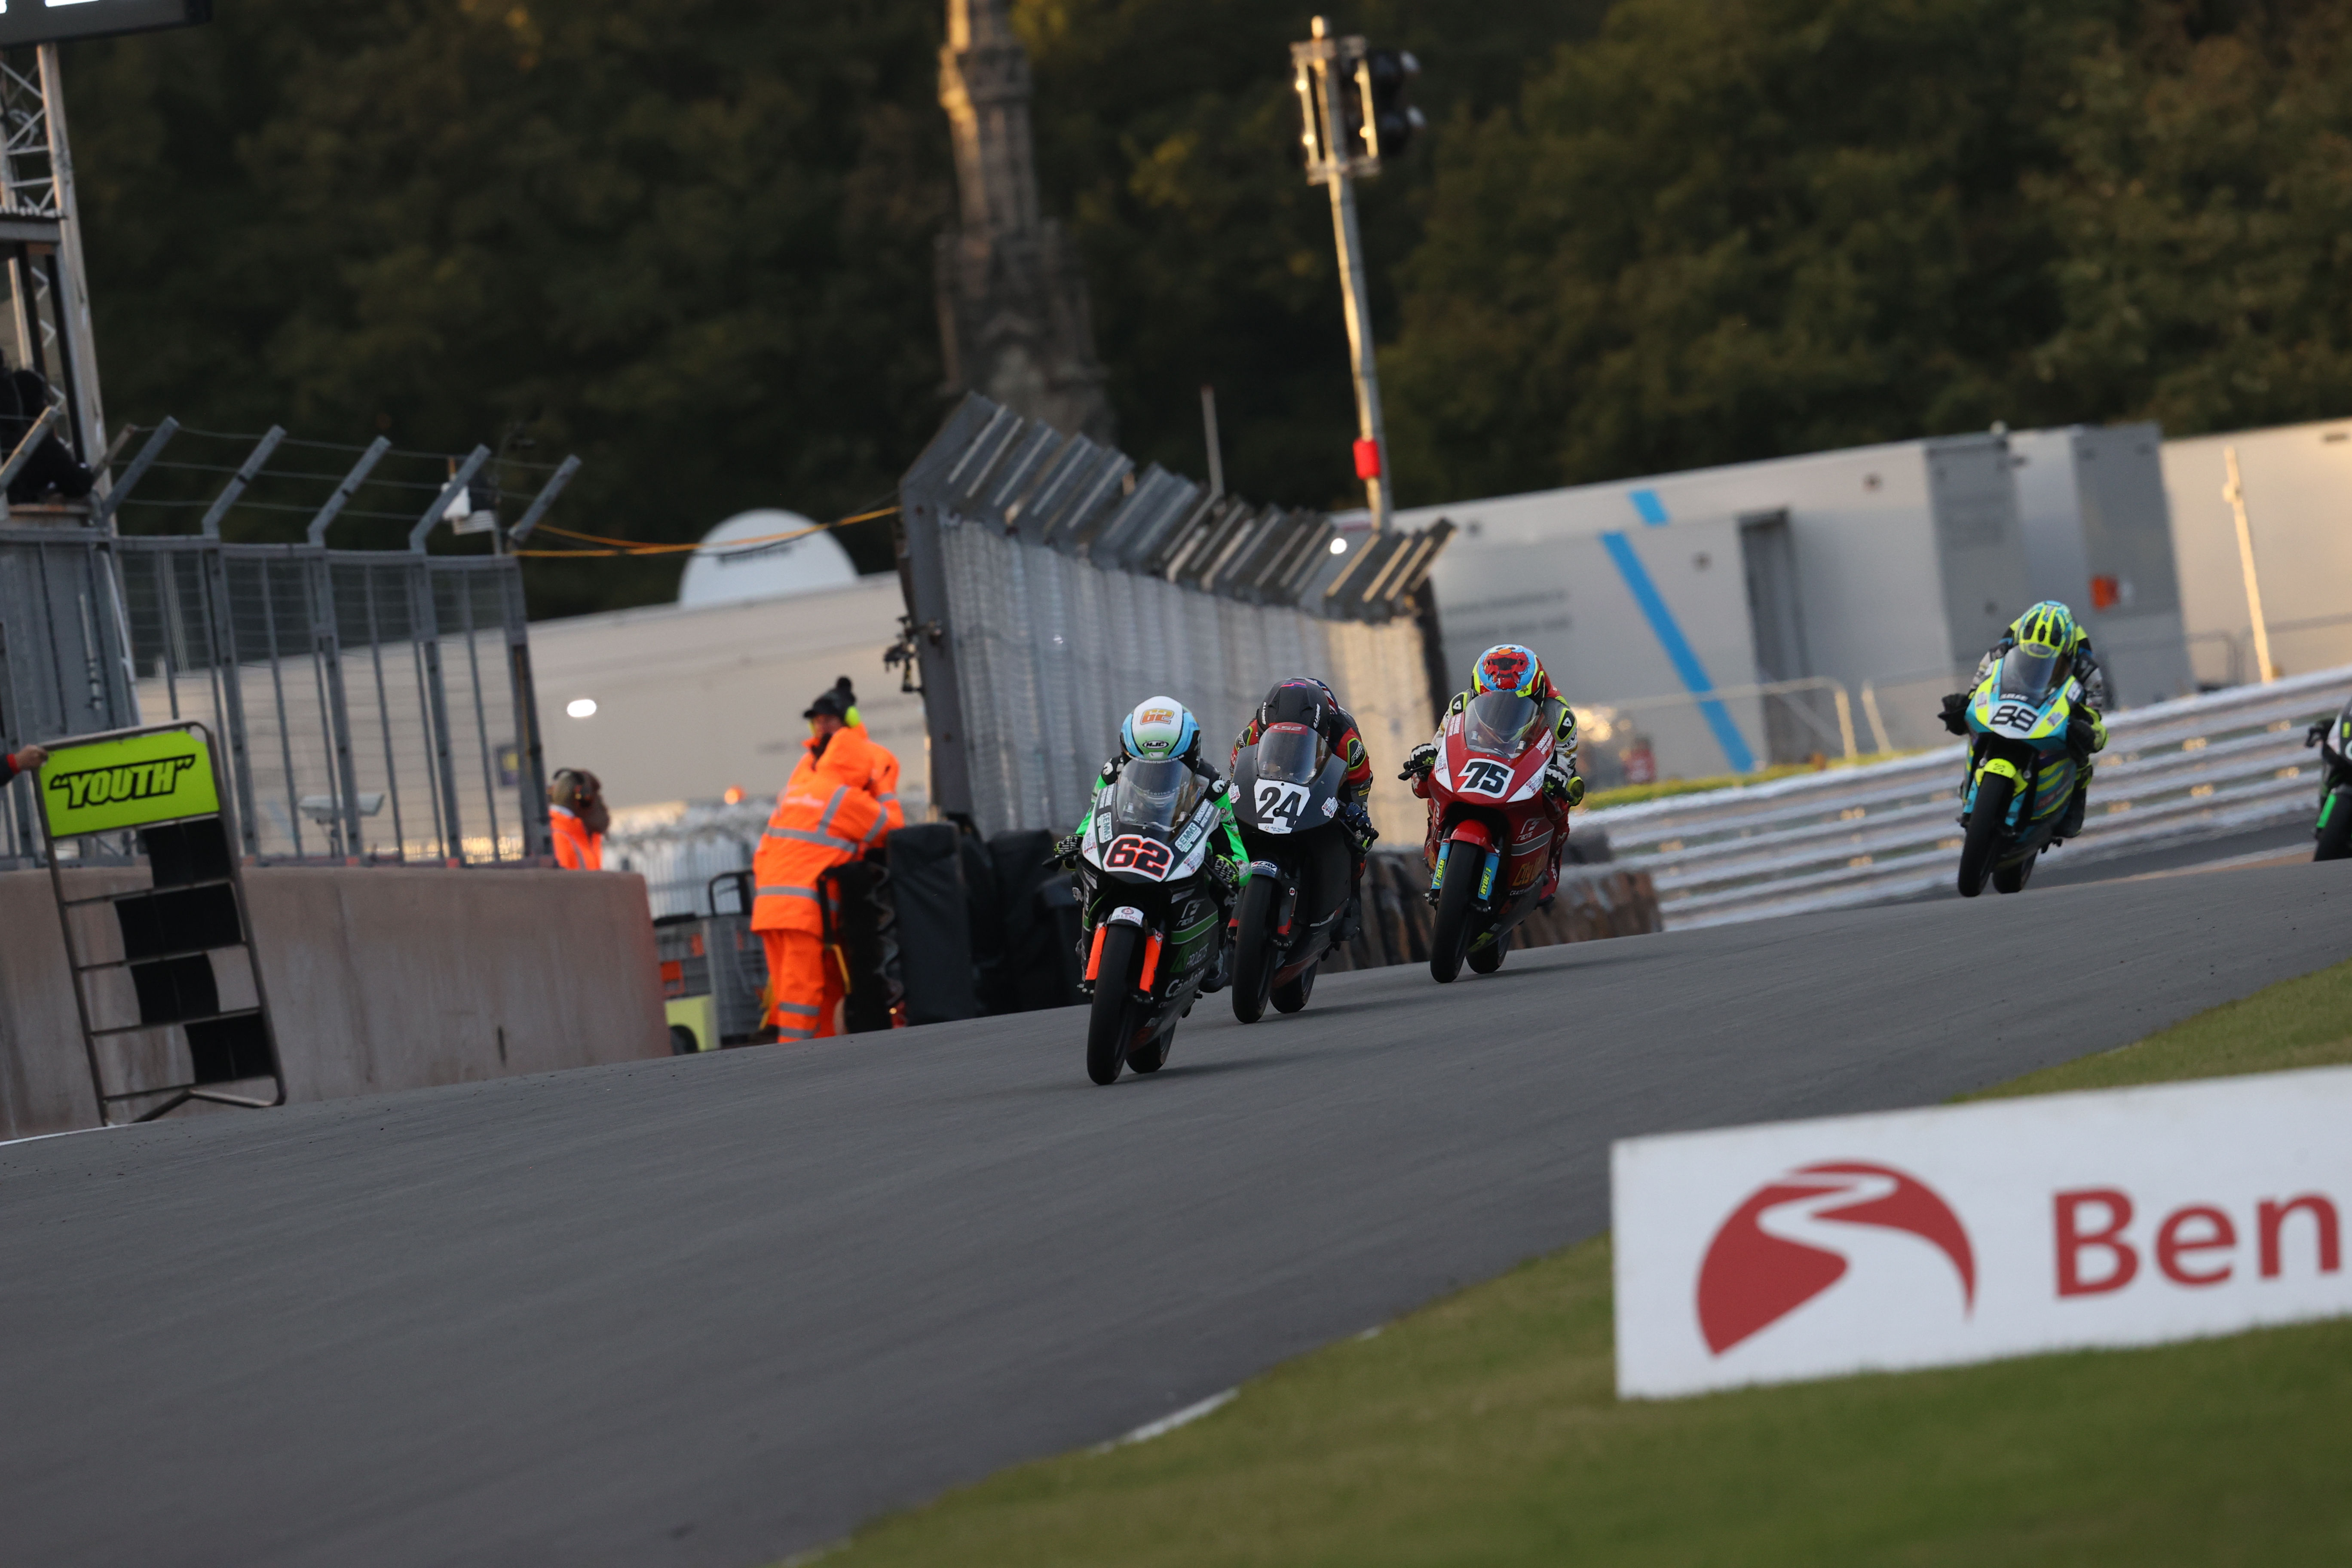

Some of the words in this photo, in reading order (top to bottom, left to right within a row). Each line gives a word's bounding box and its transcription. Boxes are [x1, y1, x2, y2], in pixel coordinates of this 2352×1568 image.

[1140, 708, 1174, 725] 62
[1990, 705, 2038, 732] 88
[1535, 729, 1551, 751] YORKSHIRE
[1464, 762, 1509, 794] 75
[1257, 787, 1302, 828] 24
[1103, 813, 1111, 840] SEMMS
[1176, 824, 1197, 849] SEMMS
[1106, 837, 1171, 879] 62
[1436, 858, 1446, 881] RYDE
[1480, 872, 1491, 895] RYDE
[2053, 1188, 2341, 1298] Ben
